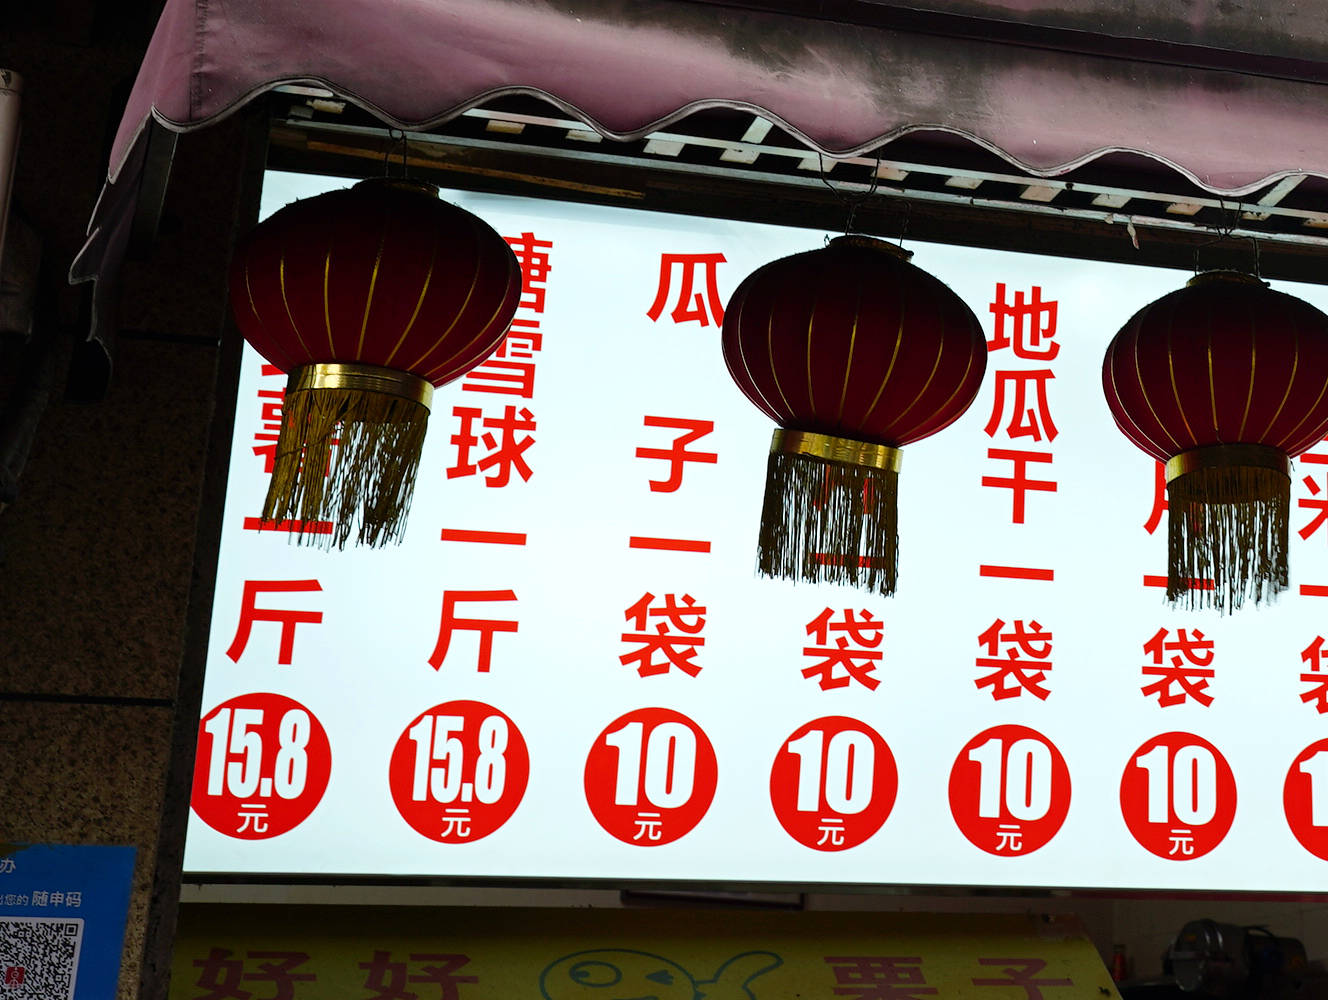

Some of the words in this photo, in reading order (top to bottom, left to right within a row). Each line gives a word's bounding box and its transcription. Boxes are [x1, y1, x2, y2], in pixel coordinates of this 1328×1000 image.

[974, 282, 1061, 701] 地瓜干一袋
[204, 707, 311, 800] 15.8
[409, 714, 509, 805] 15.8
[605, 721, 697, 809] 10
[787, 729, 875, 815] 10
[968, 738, 1052, 821] 10
[1136, 745, 1217, 826] 10
[236, 803, 269, 834] 元
[441, 808, 471, 839] 元
[633, 812, 663, 842] 元
[816, 819, 845, 847] 元
[995, 824, 1023, 852] 元
[1168, 829, 1194, 856] 元
[31, 890, 82, 908] 随申码
